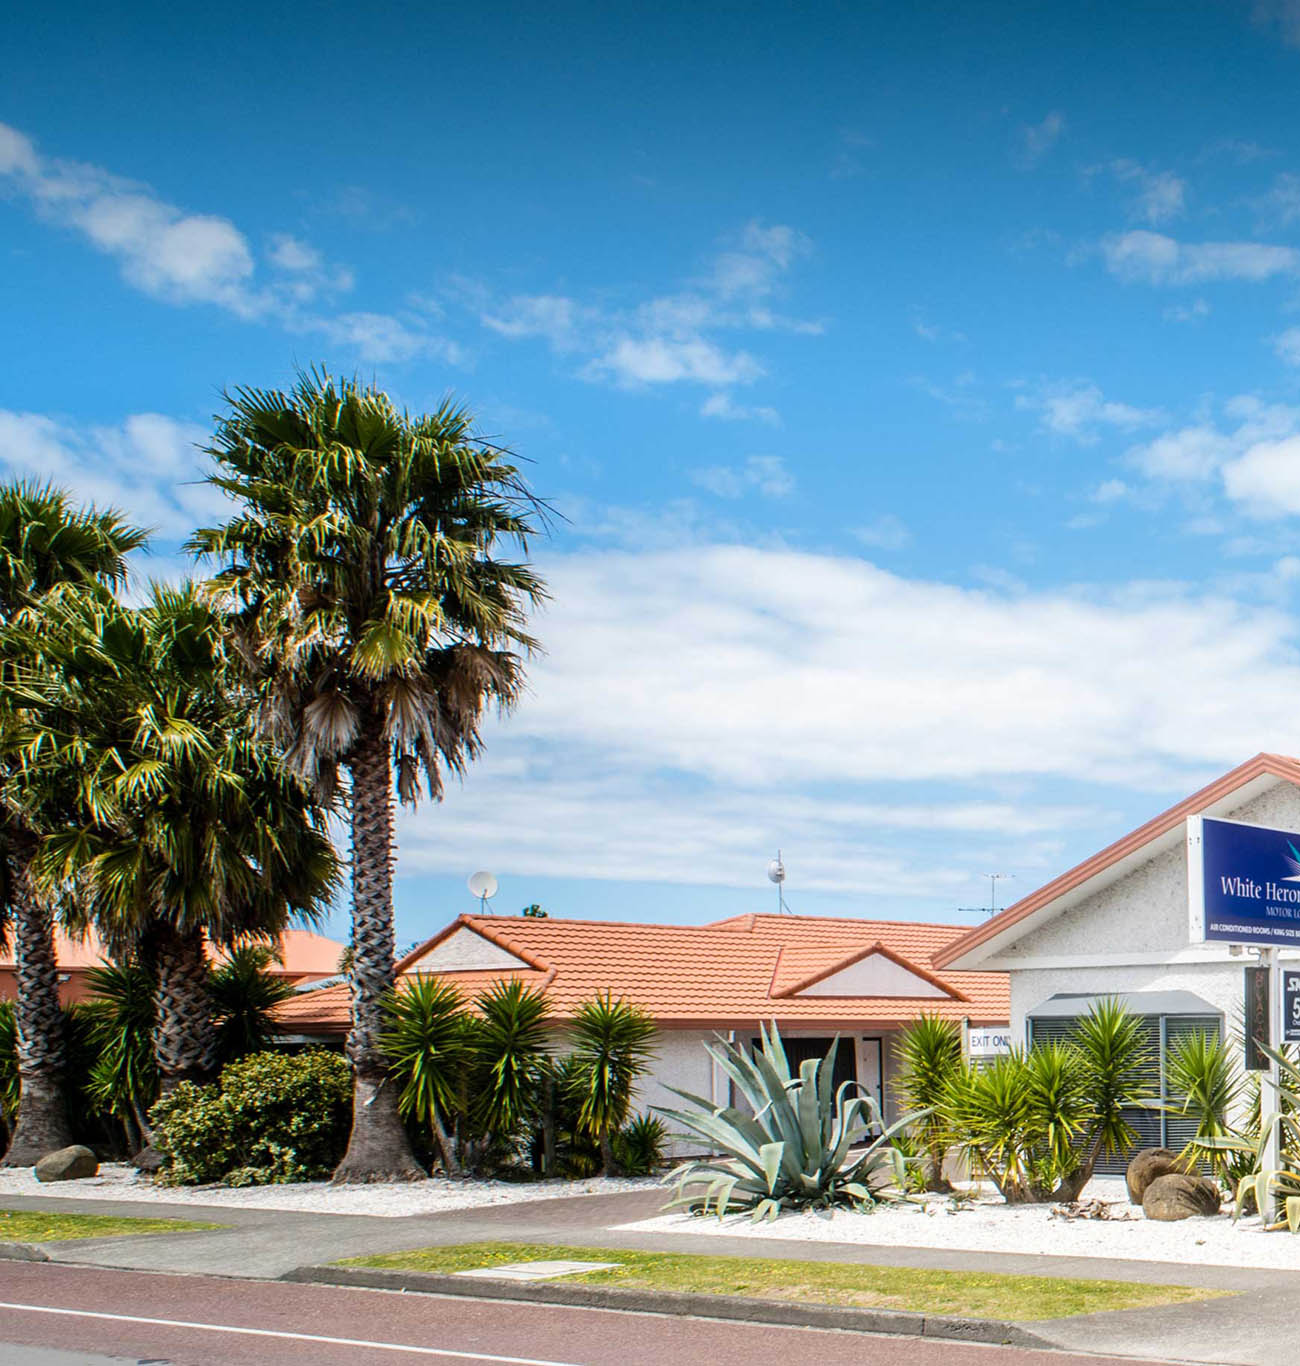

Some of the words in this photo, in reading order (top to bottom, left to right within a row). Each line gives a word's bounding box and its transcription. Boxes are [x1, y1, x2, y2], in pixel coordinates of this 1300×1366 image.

[1221, 876, 1262, 899] White
[1265, 906, 1293, 918] MOTOR
[1210, 923, 1219, 932] AIR
[1219, 924, 1252, 934] CONDITIONED
[1253, 926, 1271, 936] ROOMS
[971, 1035, 990, 1047] EXIT
